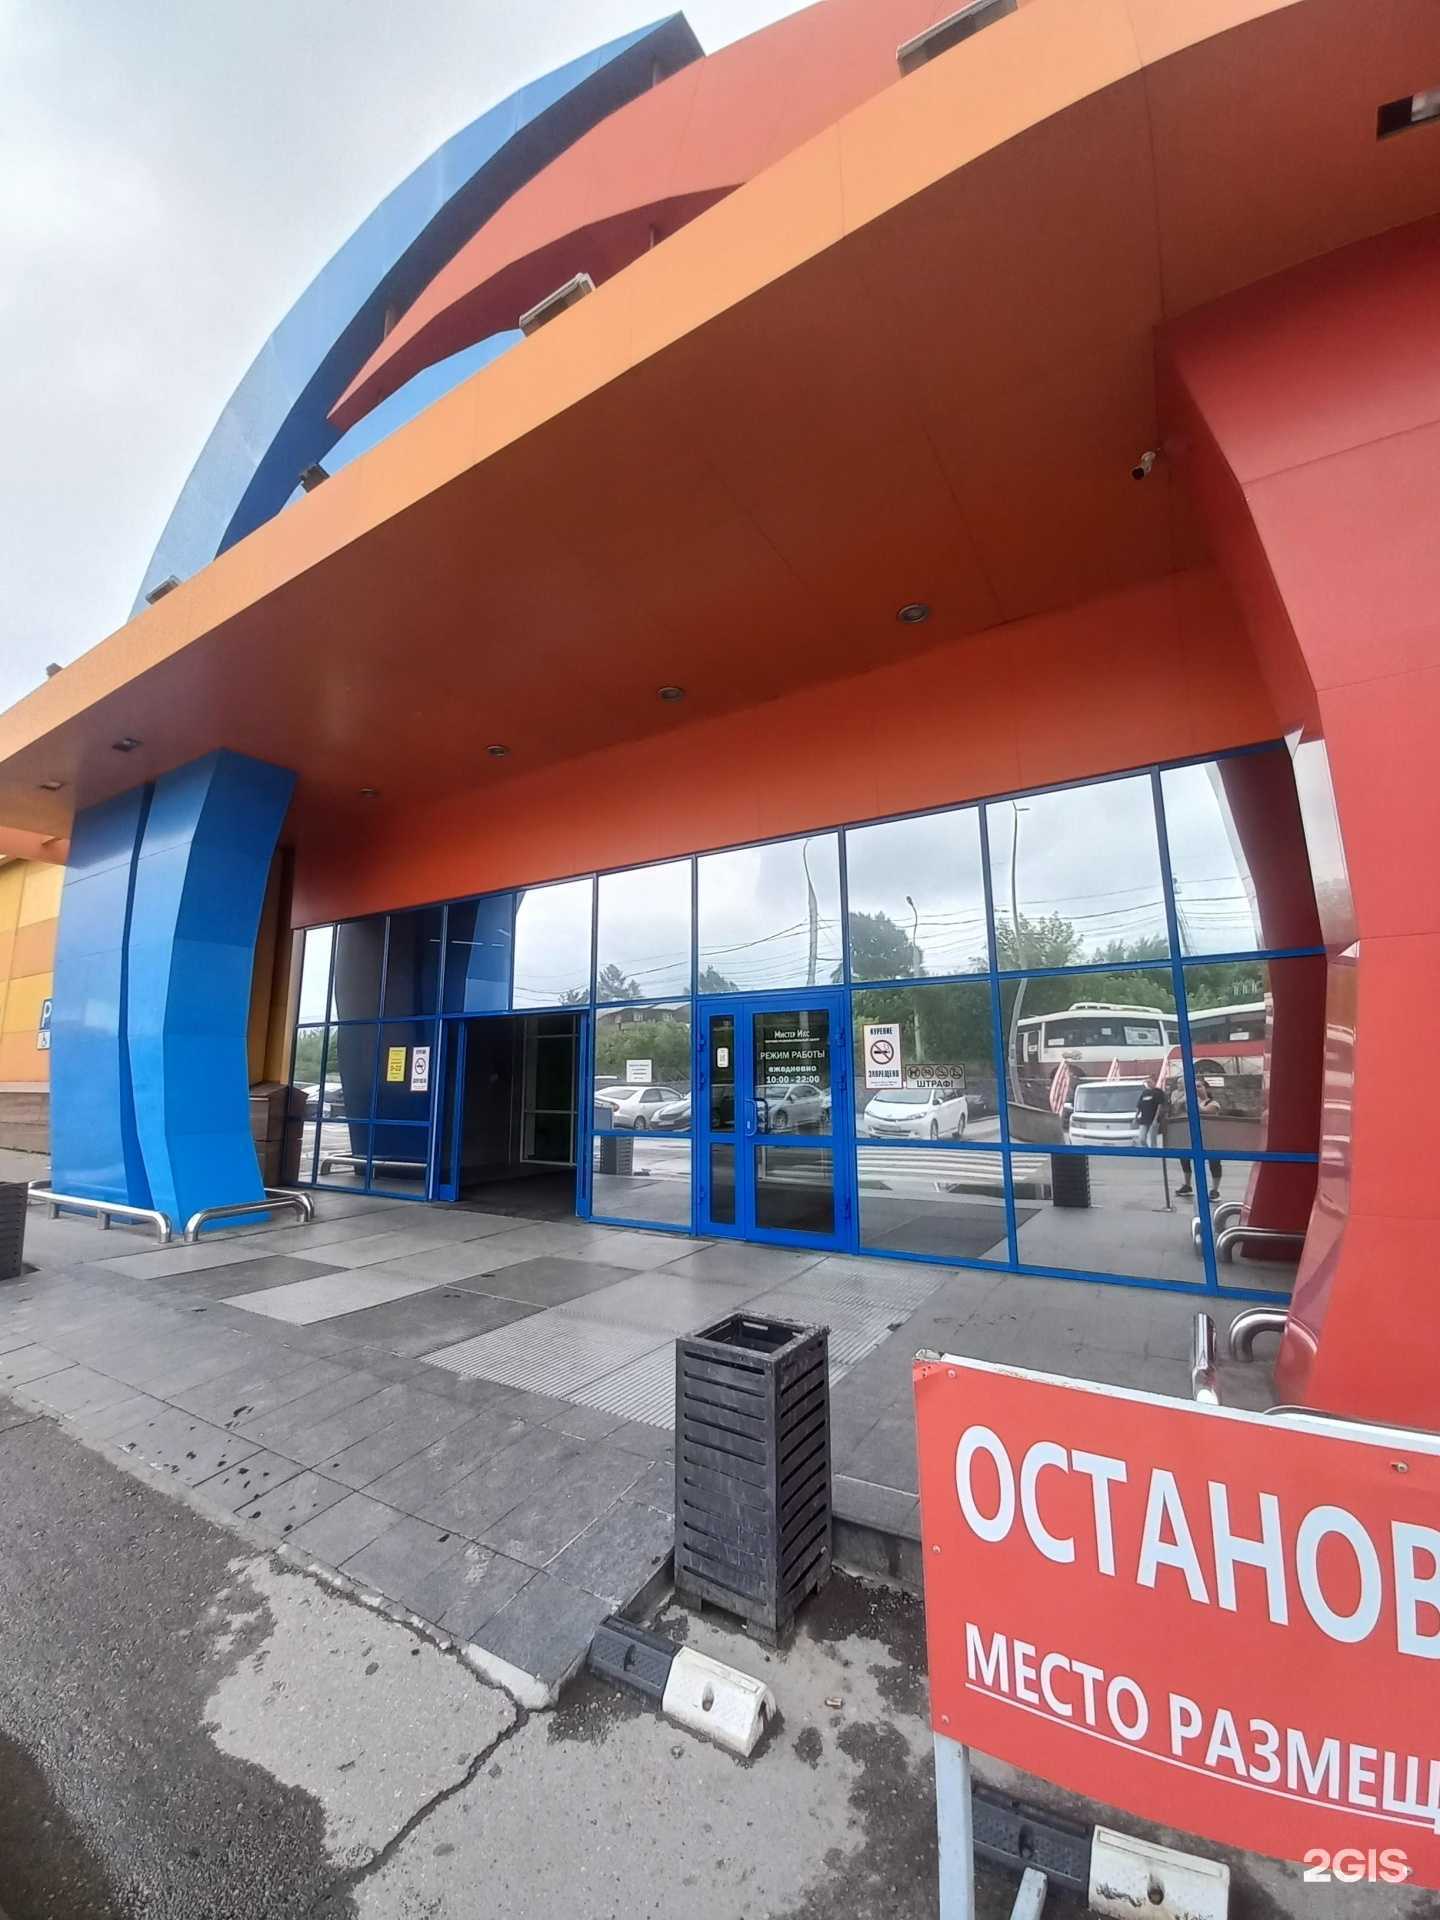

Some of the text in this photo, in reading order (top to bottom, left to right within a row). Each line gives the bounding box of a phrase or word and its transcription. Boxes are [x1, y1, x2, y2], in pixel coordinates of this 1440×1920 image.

[760, 1050, 825, 1060] РЕЖИМ РАБОТЫ
[766, 1076, 789, 1084] 10:00
[795, 1075, 820, 1083] 22:00
[916, 1080, 954, 1088] ШТРАФ!
[955, 1425, 1440, 1660] ОСТАНОВ
[965, 1622, 1440, 1835] МЕСТО РАЗМЕЩ
